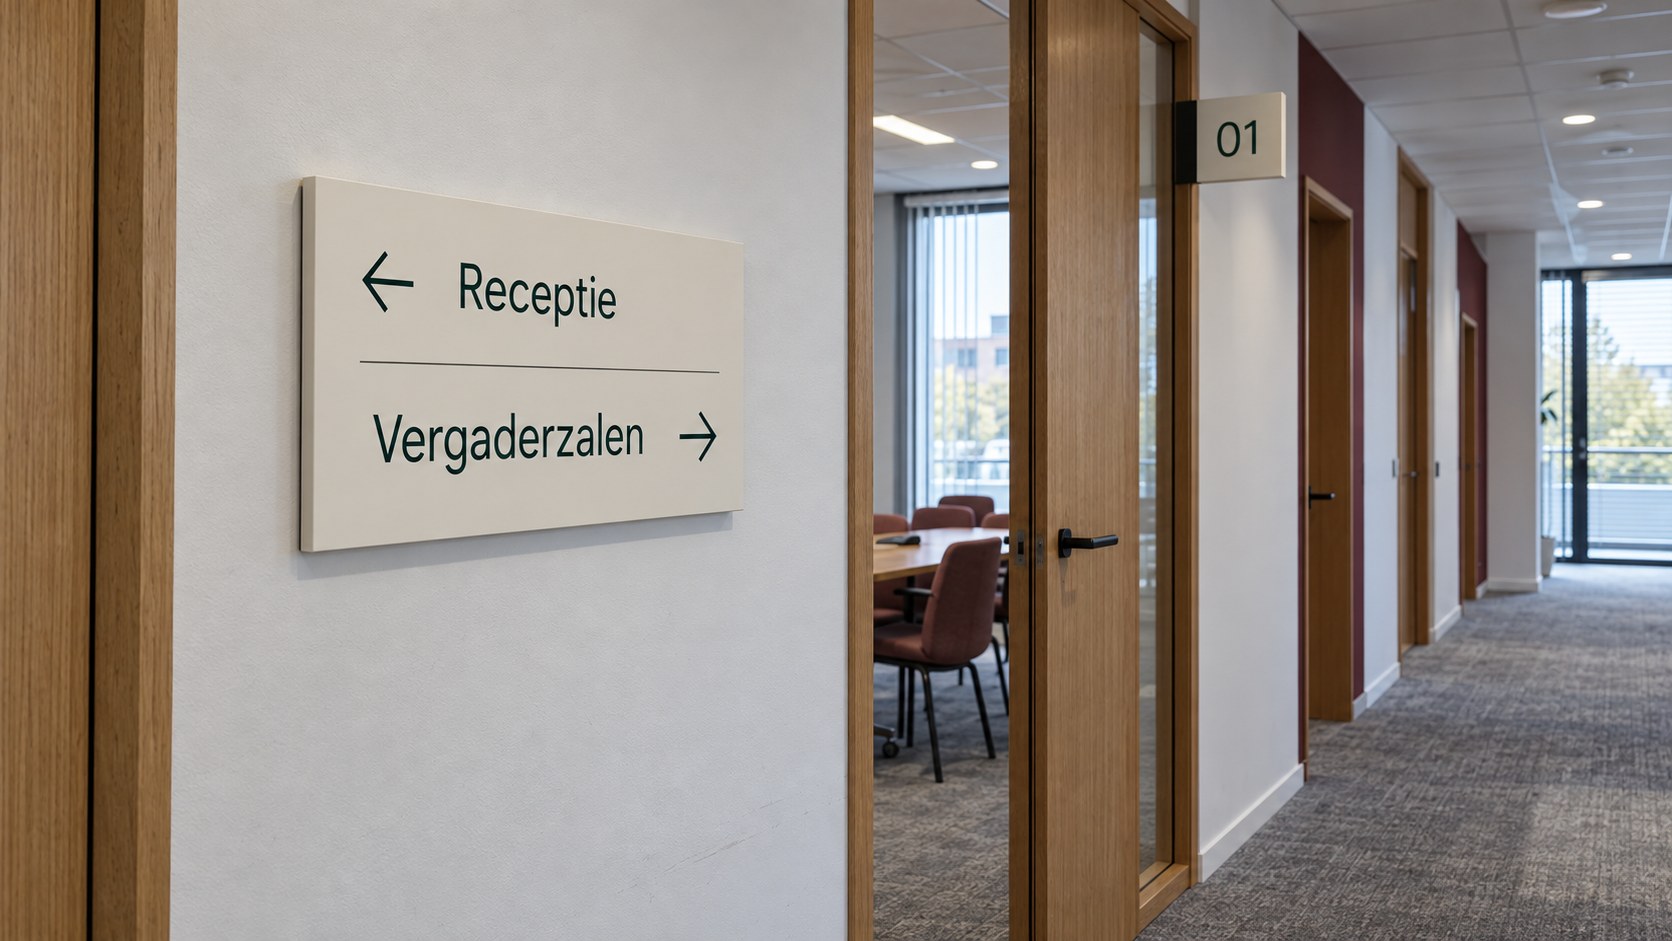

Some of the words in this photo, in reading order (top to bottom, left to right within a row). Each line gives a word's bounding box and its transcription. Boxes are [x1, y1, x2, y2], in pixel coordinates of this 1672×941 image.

[1216, 119, 1257, 158] 01
[460, 262, 617, 327] Receptie
[373, 412, 644, 475] Vergaderzalen
